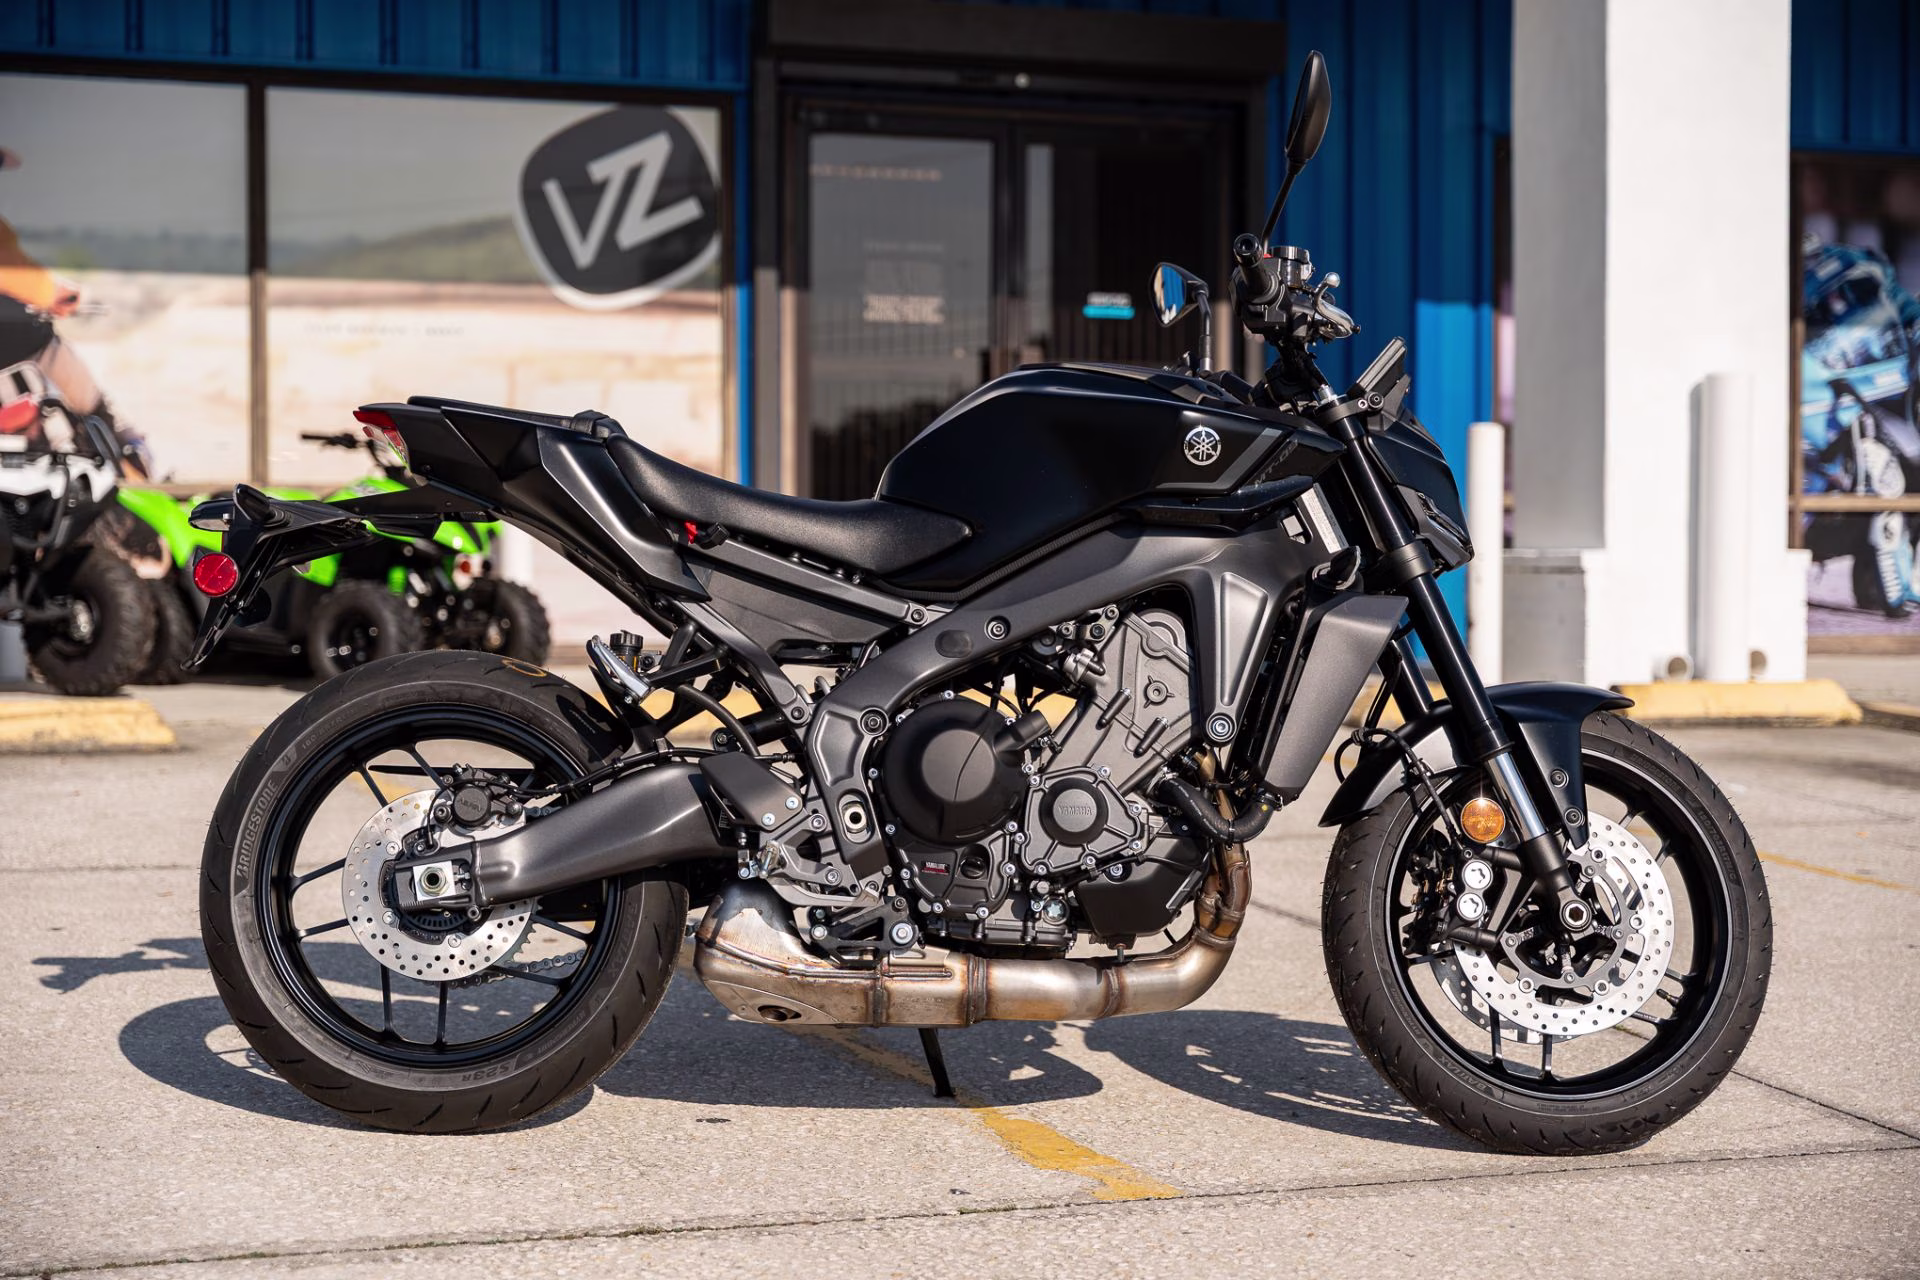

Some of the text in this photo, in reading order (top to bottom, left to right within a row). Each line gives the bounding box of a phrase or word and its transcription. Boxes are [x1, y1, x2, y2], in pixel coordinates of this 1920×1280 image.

[1253, 438, 1299, 488] MT-09
[236, 779, 279, 881] BRIDGESTONE
[1058, 804, 1093, 817] YAMAHA
